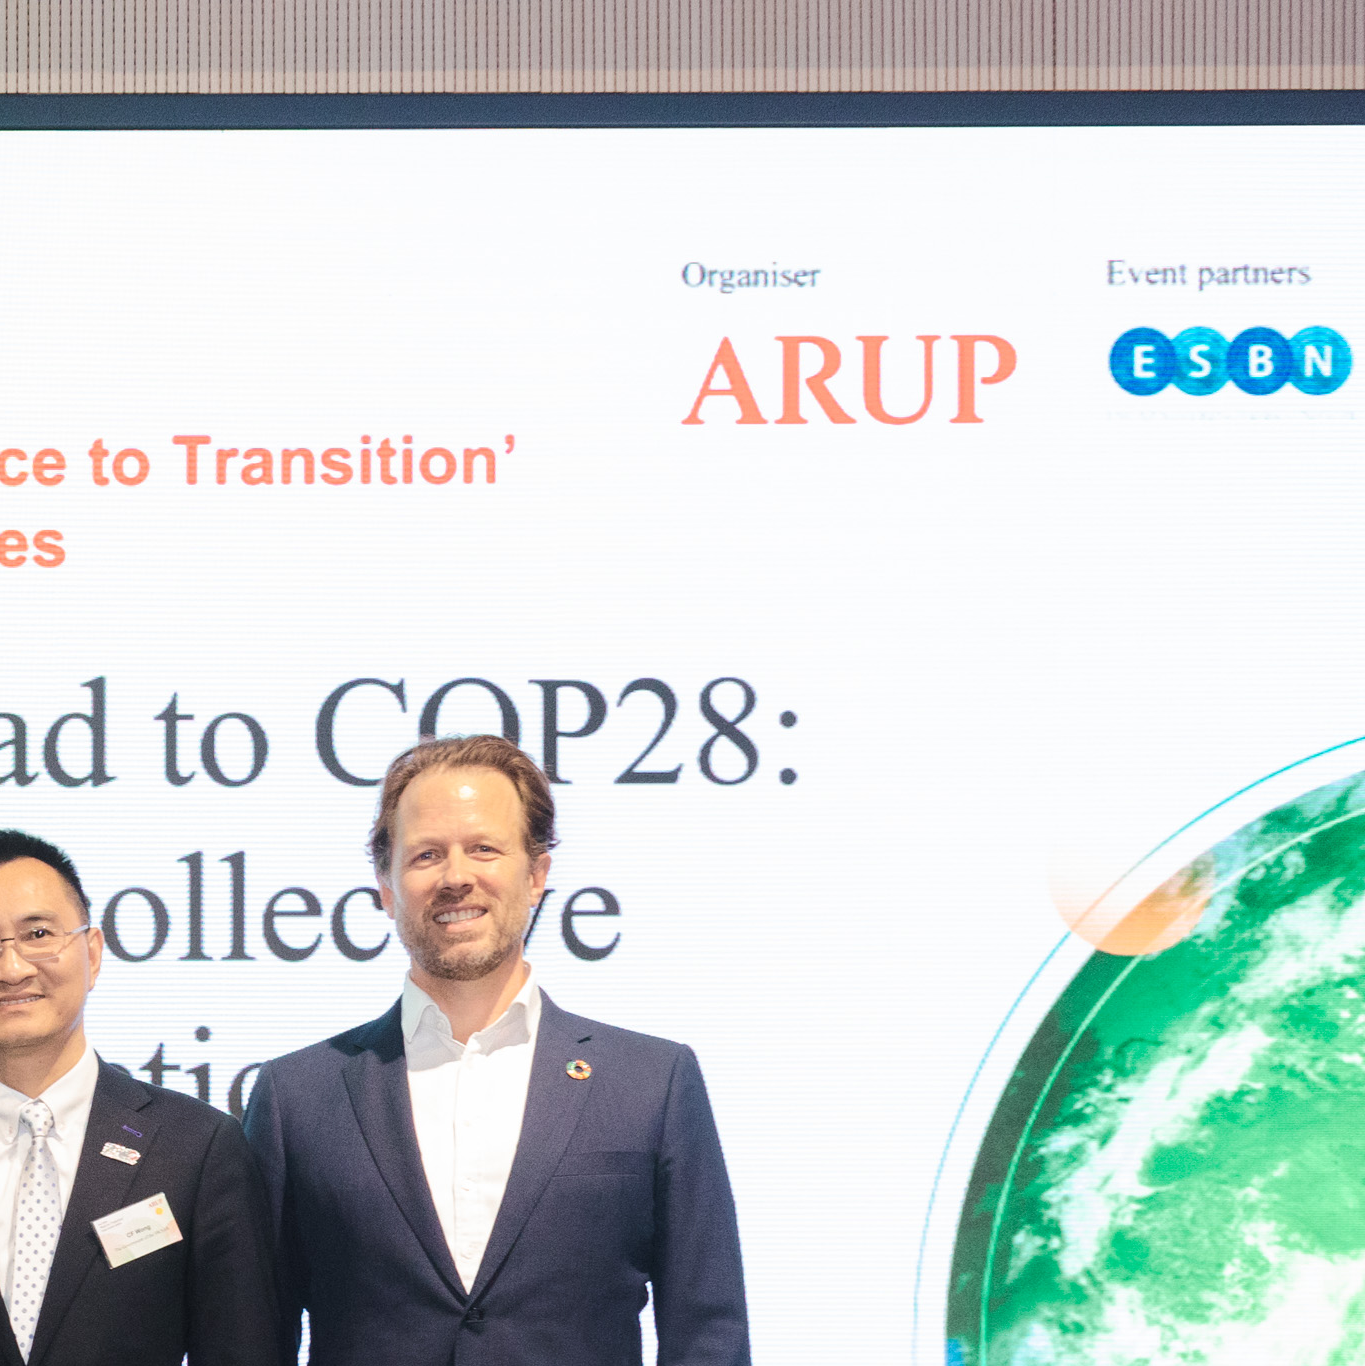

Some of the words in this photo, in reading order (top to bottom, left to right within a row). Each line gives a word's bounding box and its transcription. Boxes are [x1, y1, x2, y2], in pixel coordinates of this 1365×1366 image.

[681, 261, 821, 294] Organiser
[1107, 259, 1188, 286] Event
[1198, 262, 1312, 292] partners
[681, 334, 1017, 426] ARUP
[89, 438, 150, 487] to
[155, 697, 269, 788] to
